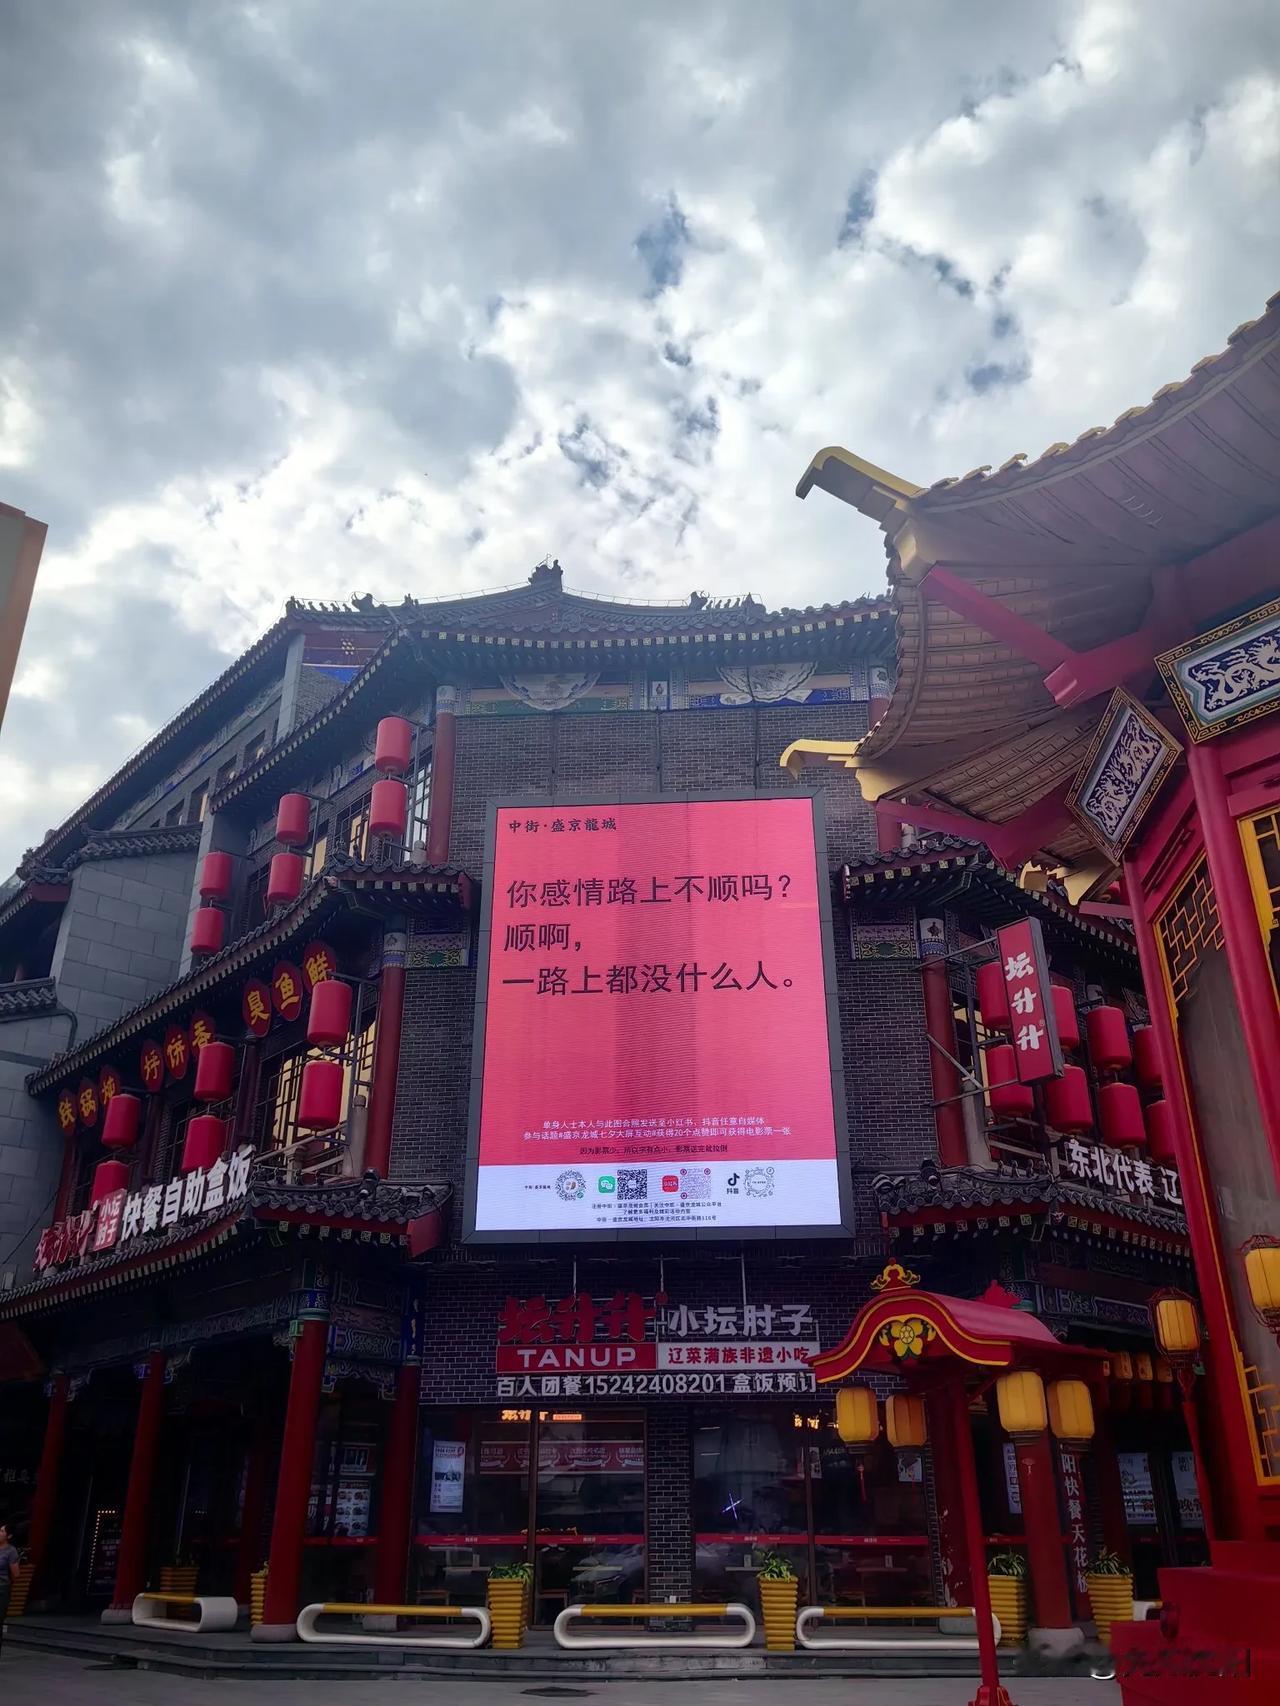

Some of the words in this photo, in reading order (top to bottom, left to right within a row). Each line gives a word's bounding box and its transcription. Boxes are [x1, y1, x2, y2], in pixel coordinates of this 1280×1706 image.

[509, 818, 617, 833] 中街·盛京龍城
[246, 950, 330, 1025] 臭鱼鲜
[502, 960, 794, 996] 一路上都没什么人。
[1004, 951, 1044, 1051] 坛升升
[1067, 1138, 1155, 1197] 东北代表
[121, 1145, 257, 1242] 快餐自助盒饭
[668, 1304, 813, 1336] 小坛肘子
[517, 1348, 637, 1367] TANUP
[668, 1347, 811, 1364] 辽菜满族非遗小吃
